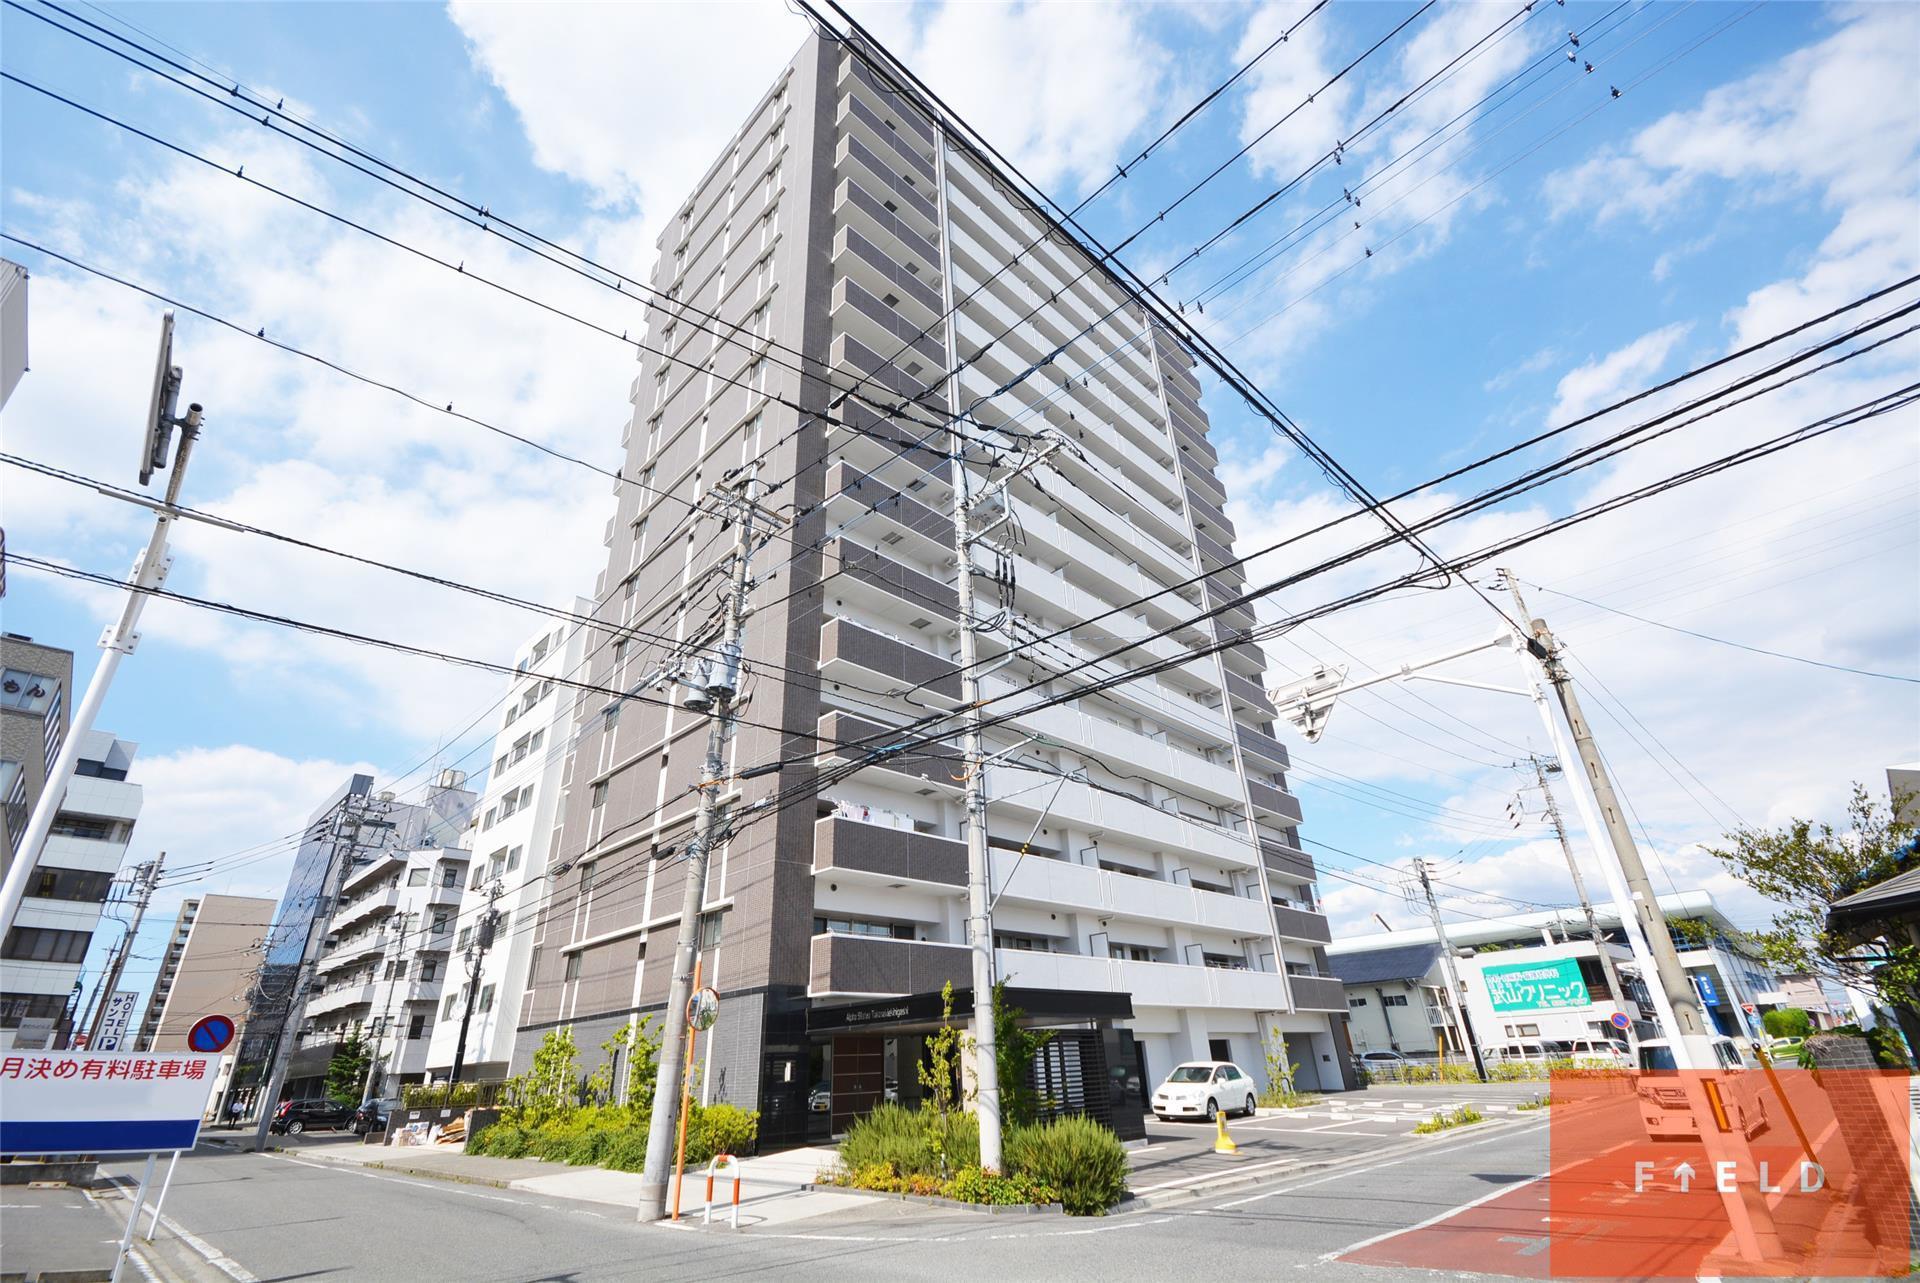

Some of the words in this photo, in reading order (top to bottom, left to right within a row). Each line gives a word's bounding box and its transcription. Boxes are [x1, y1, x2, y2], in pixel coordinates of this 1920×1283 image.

[104, 997, 123, 1036] サンコー
[113, 994, 135, 1036] HOTEL
[99, 1037, 116, 1051] P
[0, 1057, 207, 1080] 月決め有料駐車場
